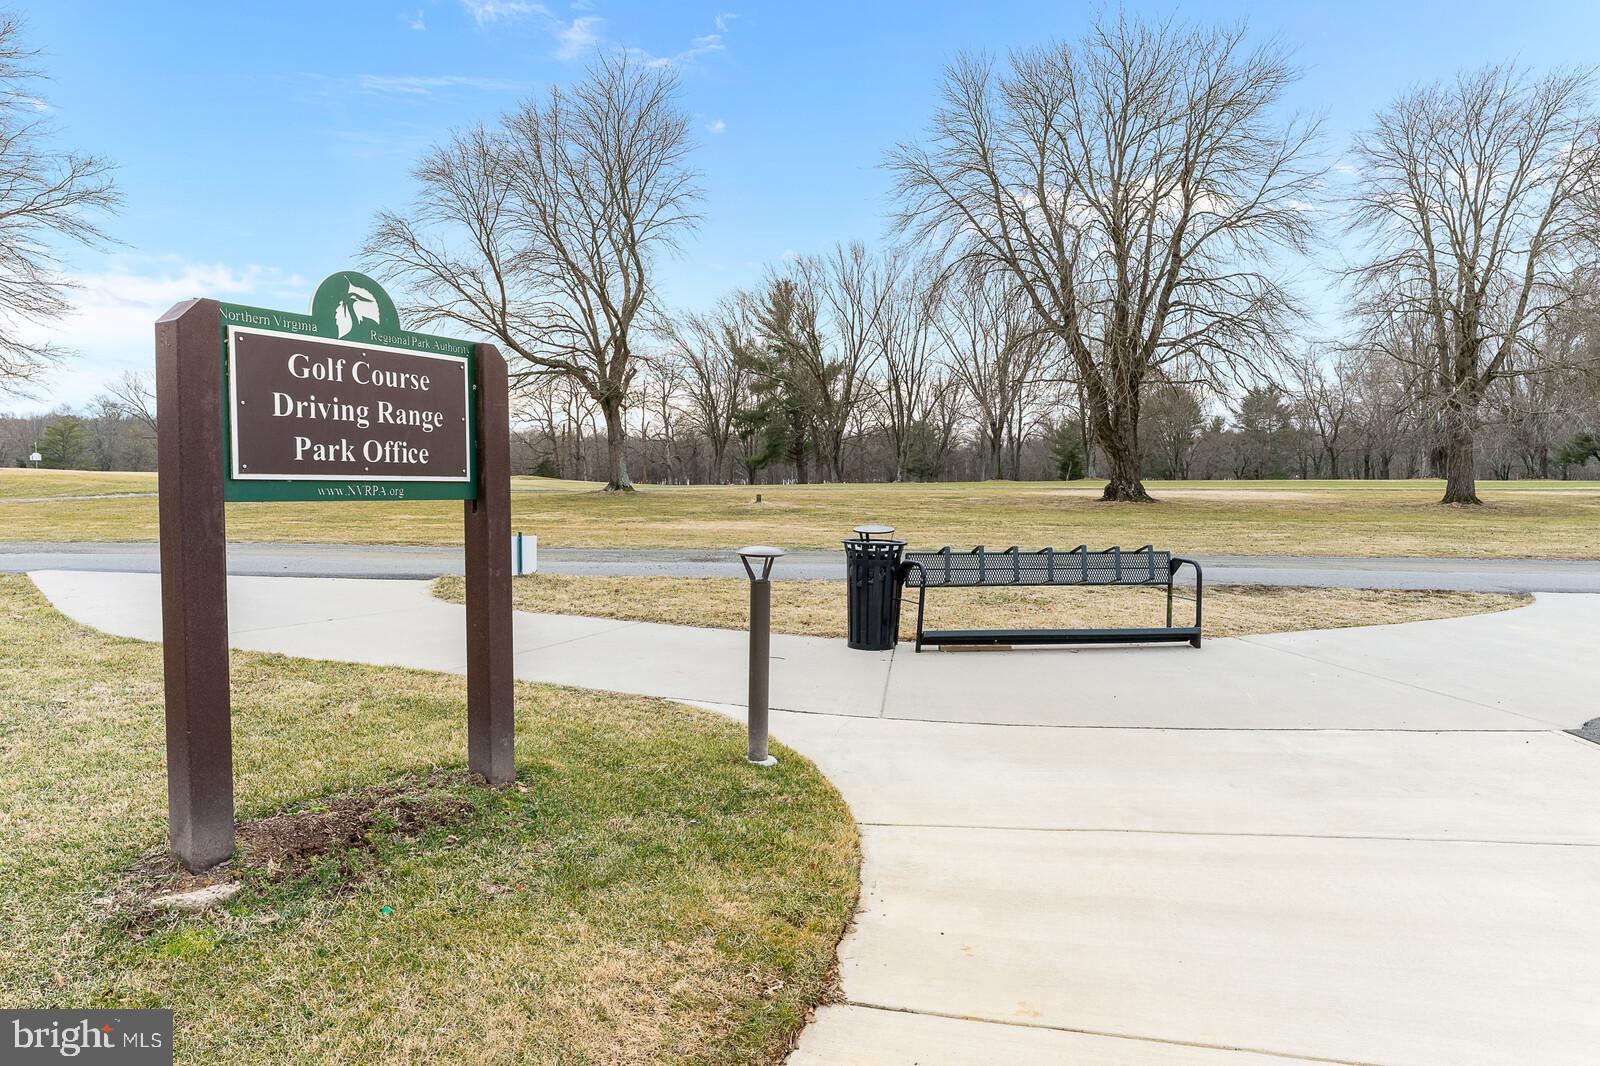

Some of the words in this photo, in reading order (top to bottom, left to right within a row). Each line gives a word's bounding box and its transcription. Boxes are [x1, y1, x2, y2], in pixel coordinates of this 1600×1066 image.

[219, 308, 271, 326] Northern
[273, 315, 318, 333] Virginia
[370, 330, 410, 345] Regional
[411, 336, 431, 349] Park
[287, 353, 346, 382] Golf
[351, 361, 431, 391] Course
[272, 391, 370, 428] Driving
[377, 400, 444, 433] Range
[294, 436, 356, 462] Park
[363, 439, 430, 464] Office
[317, 485, 404, 498] www.NVRPA.org
